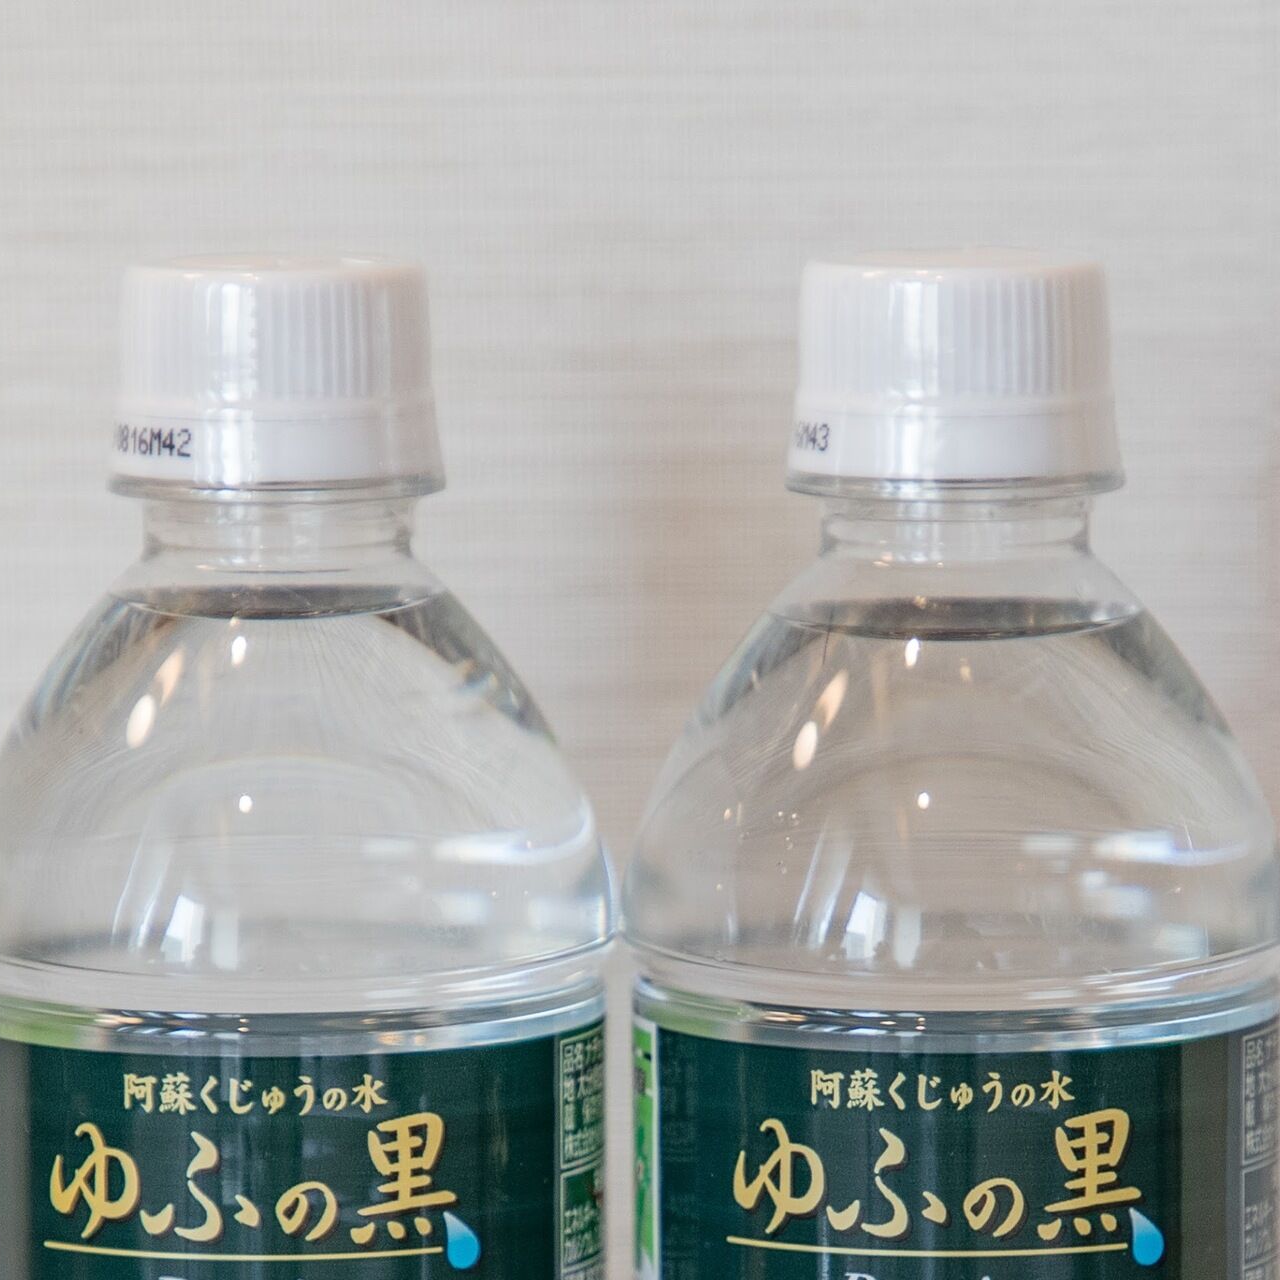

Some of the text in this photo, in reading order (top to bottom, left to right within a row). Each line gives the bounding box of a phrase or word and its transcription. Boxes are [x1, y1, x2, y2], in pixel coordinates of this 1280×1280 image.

[123, 1073, 388, 1116] 阿蘇くじゅうの水
[810, 1069, 1075, 1111] 阿蘇くじゅうの水
[49, 1111, 457, 1245] ゆふの黒
[733, 1107, 1142, 1240] ゆふの黒
